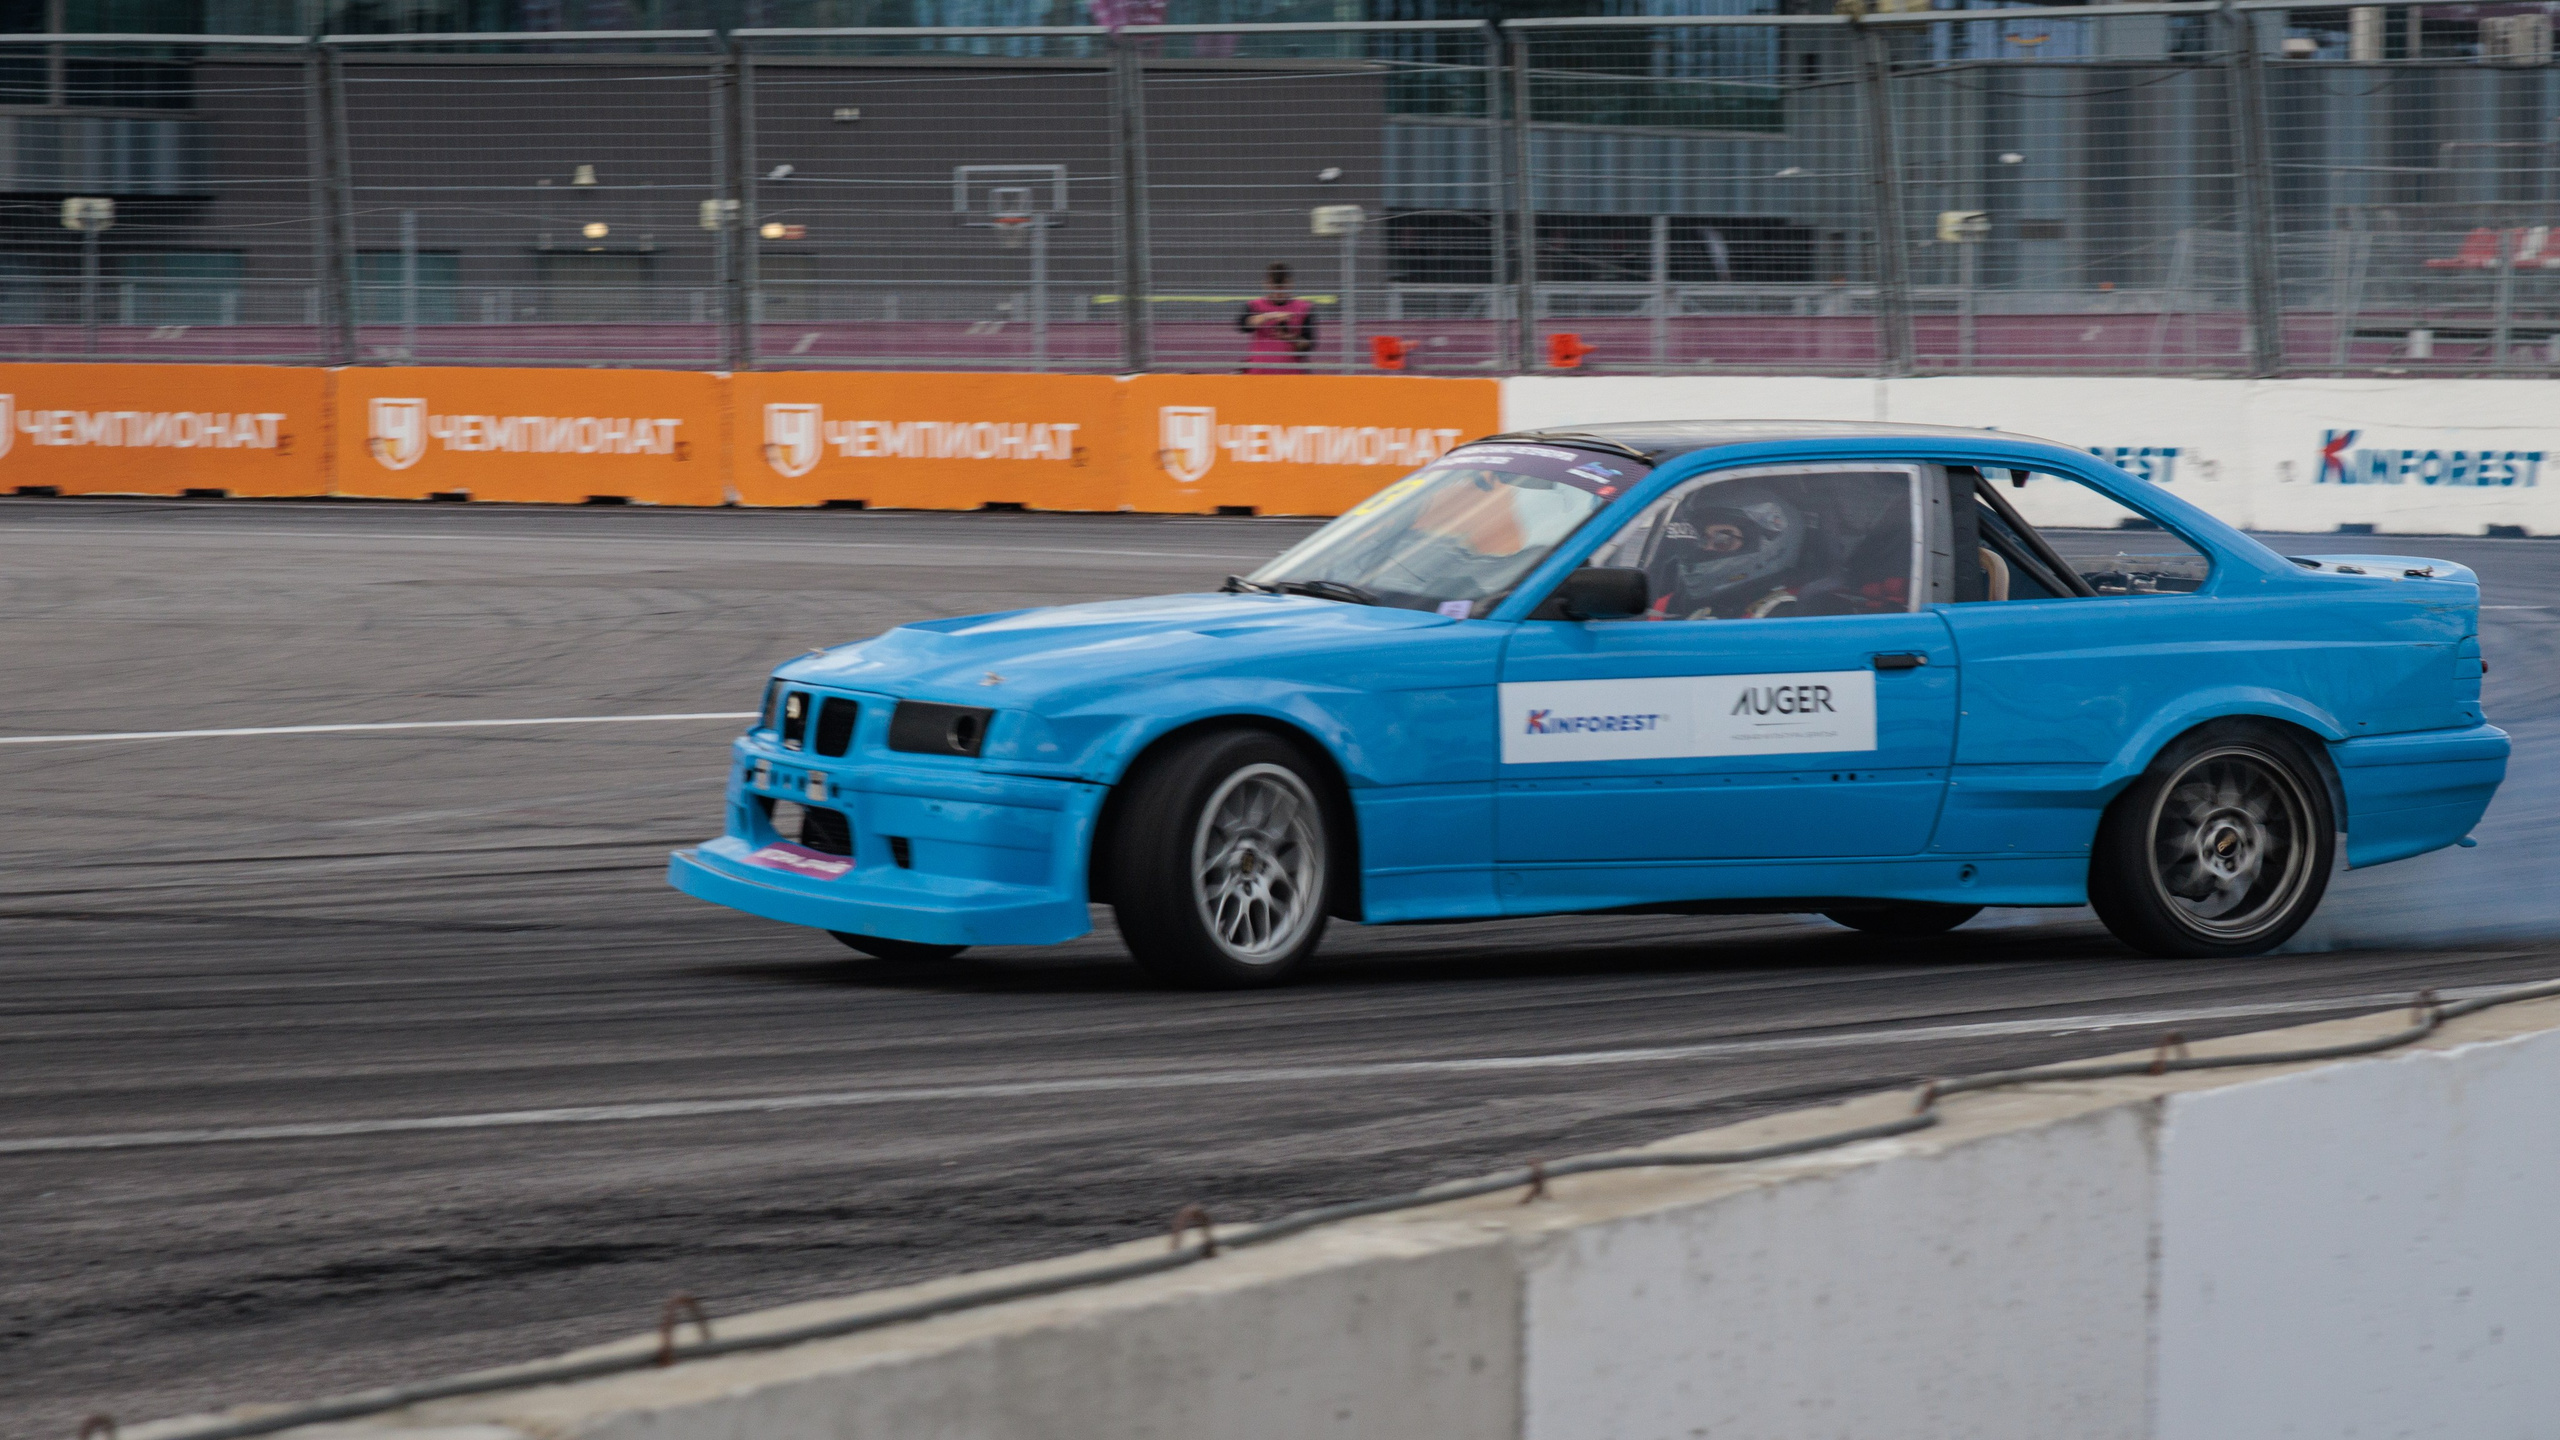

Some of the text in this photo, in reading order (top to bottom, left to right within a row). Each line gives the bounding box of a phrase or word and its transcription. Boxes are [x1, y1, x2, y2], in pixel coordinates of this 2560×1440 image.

[16, 410, 287, 449] ЧЕМПИОНАТ
[427, 415, 684, 454] ЧЕМПИОНАТ
[823, 420, 1080, 460] ЧЕМПИОНАТ
[1216, 424, 1462, 466] ЧЕМПИОНАТ
[2313, 429, 2548, 487] KINFOREST
[1730, 684, 1838, 715] AUGER
[1525, 709, 1660, 735] KINFOREST
